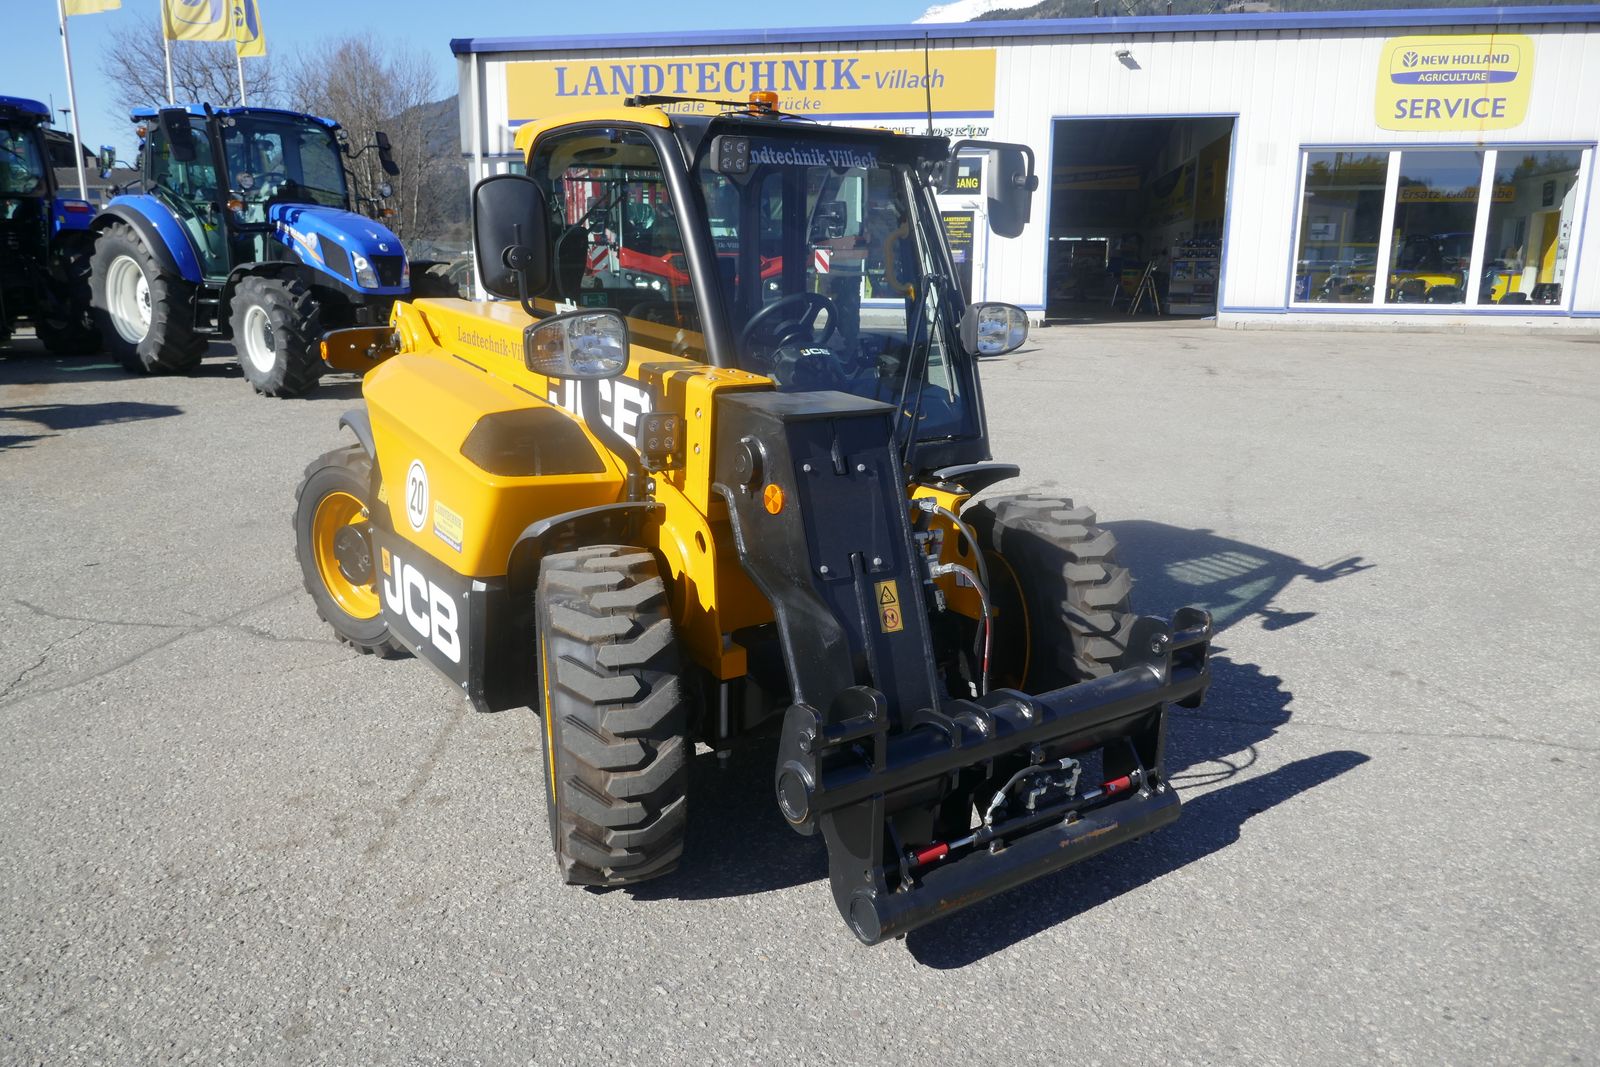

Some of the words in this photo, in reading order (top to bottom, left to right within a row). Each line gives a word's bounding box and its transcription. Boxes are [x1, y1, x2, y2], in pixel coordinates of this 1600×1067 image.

[1421, 55, 1449, 65] NEW
[1452, 54, 1510, 64] HOLLAND
[1418, 72, 1487, 82] AGRICULTURE
[1394, 97, 1507, 119] SERVICE
[750, 147, 879, 168] ndtechnik-Villach
[410, 477, 424, 515] 20
[383, 555, 461, 664] JCB
